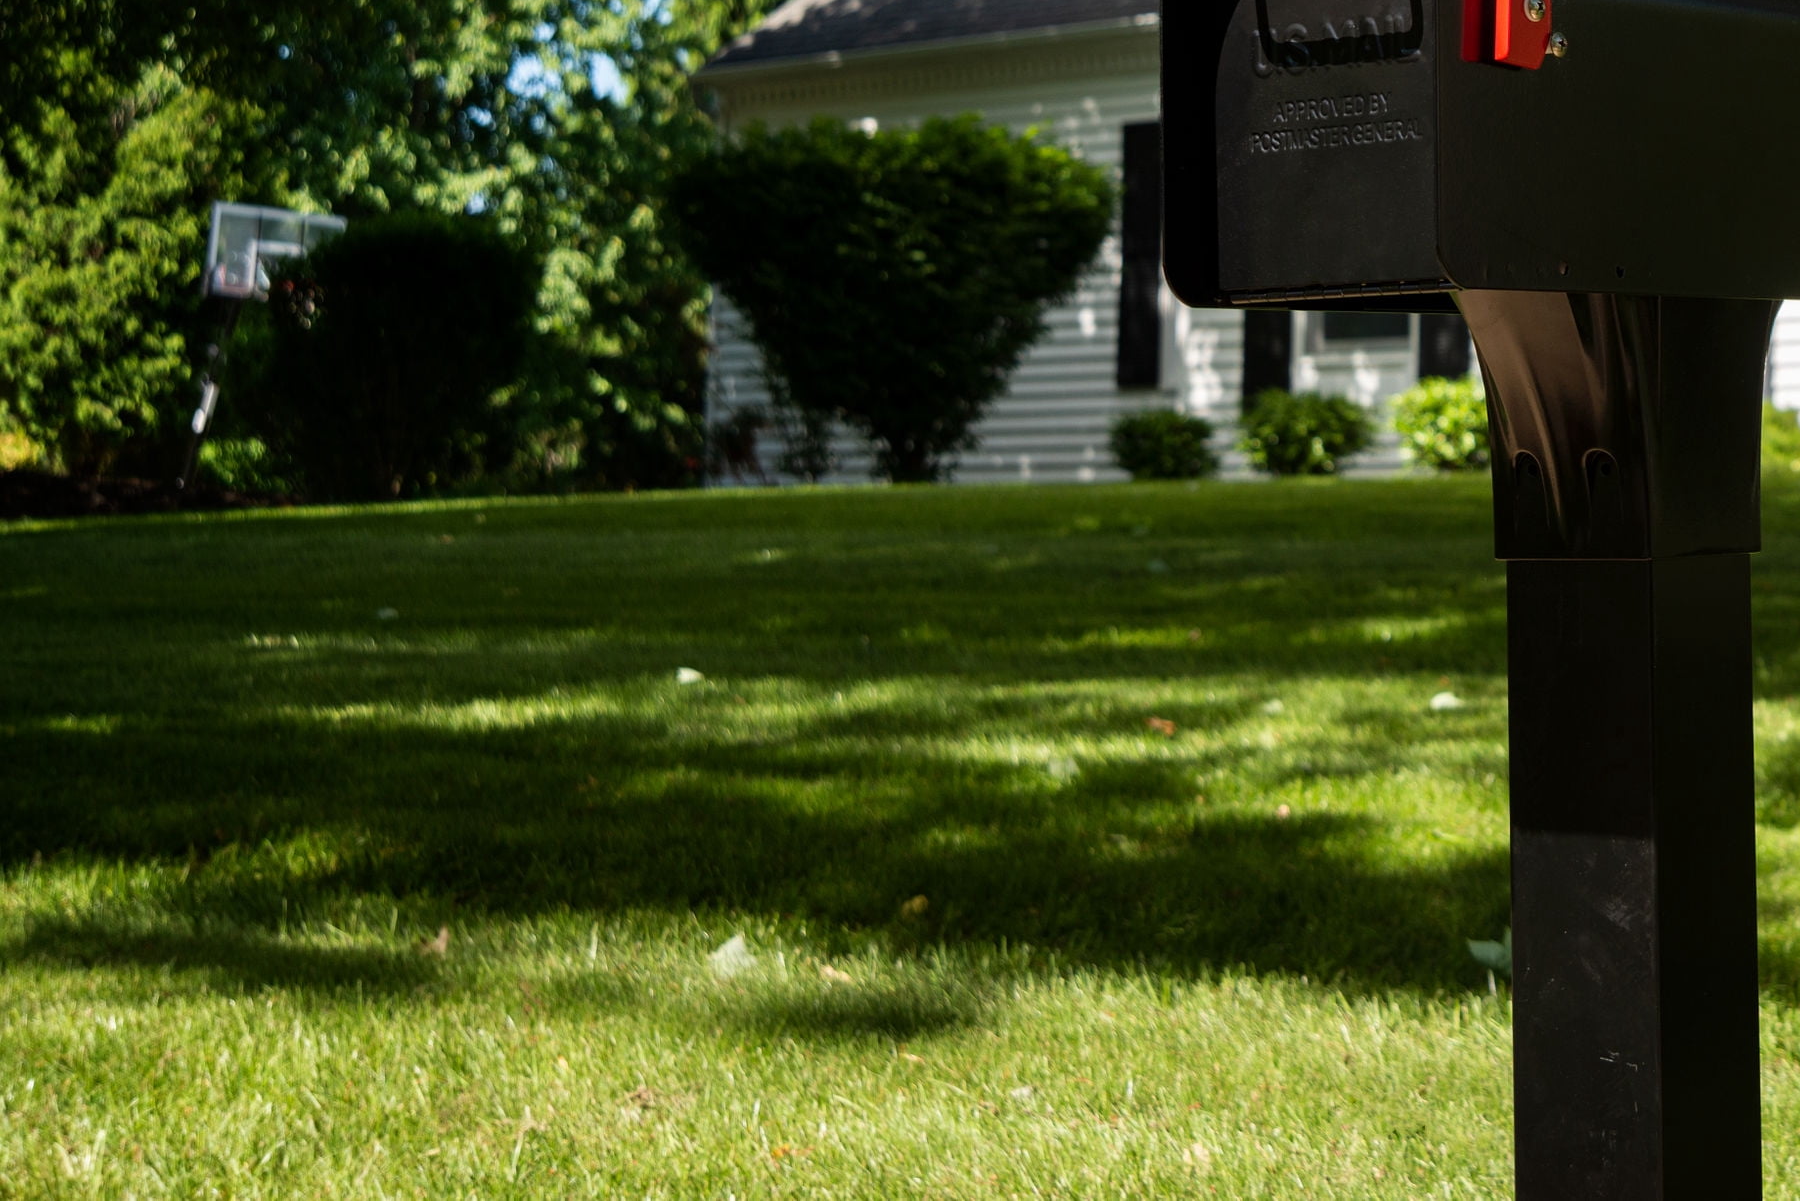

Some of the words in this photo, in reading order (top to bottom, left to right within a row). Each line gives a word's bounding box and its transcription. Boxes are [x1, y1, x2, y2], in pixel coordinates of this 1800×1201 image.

[1273, 95, 1365, 123] APPROVED
[1368, 92, 1392, 115] BY
[1250, 126, 1350, 154] POSTMASTER
[1352, 118, 1423, 146] GENERAL
